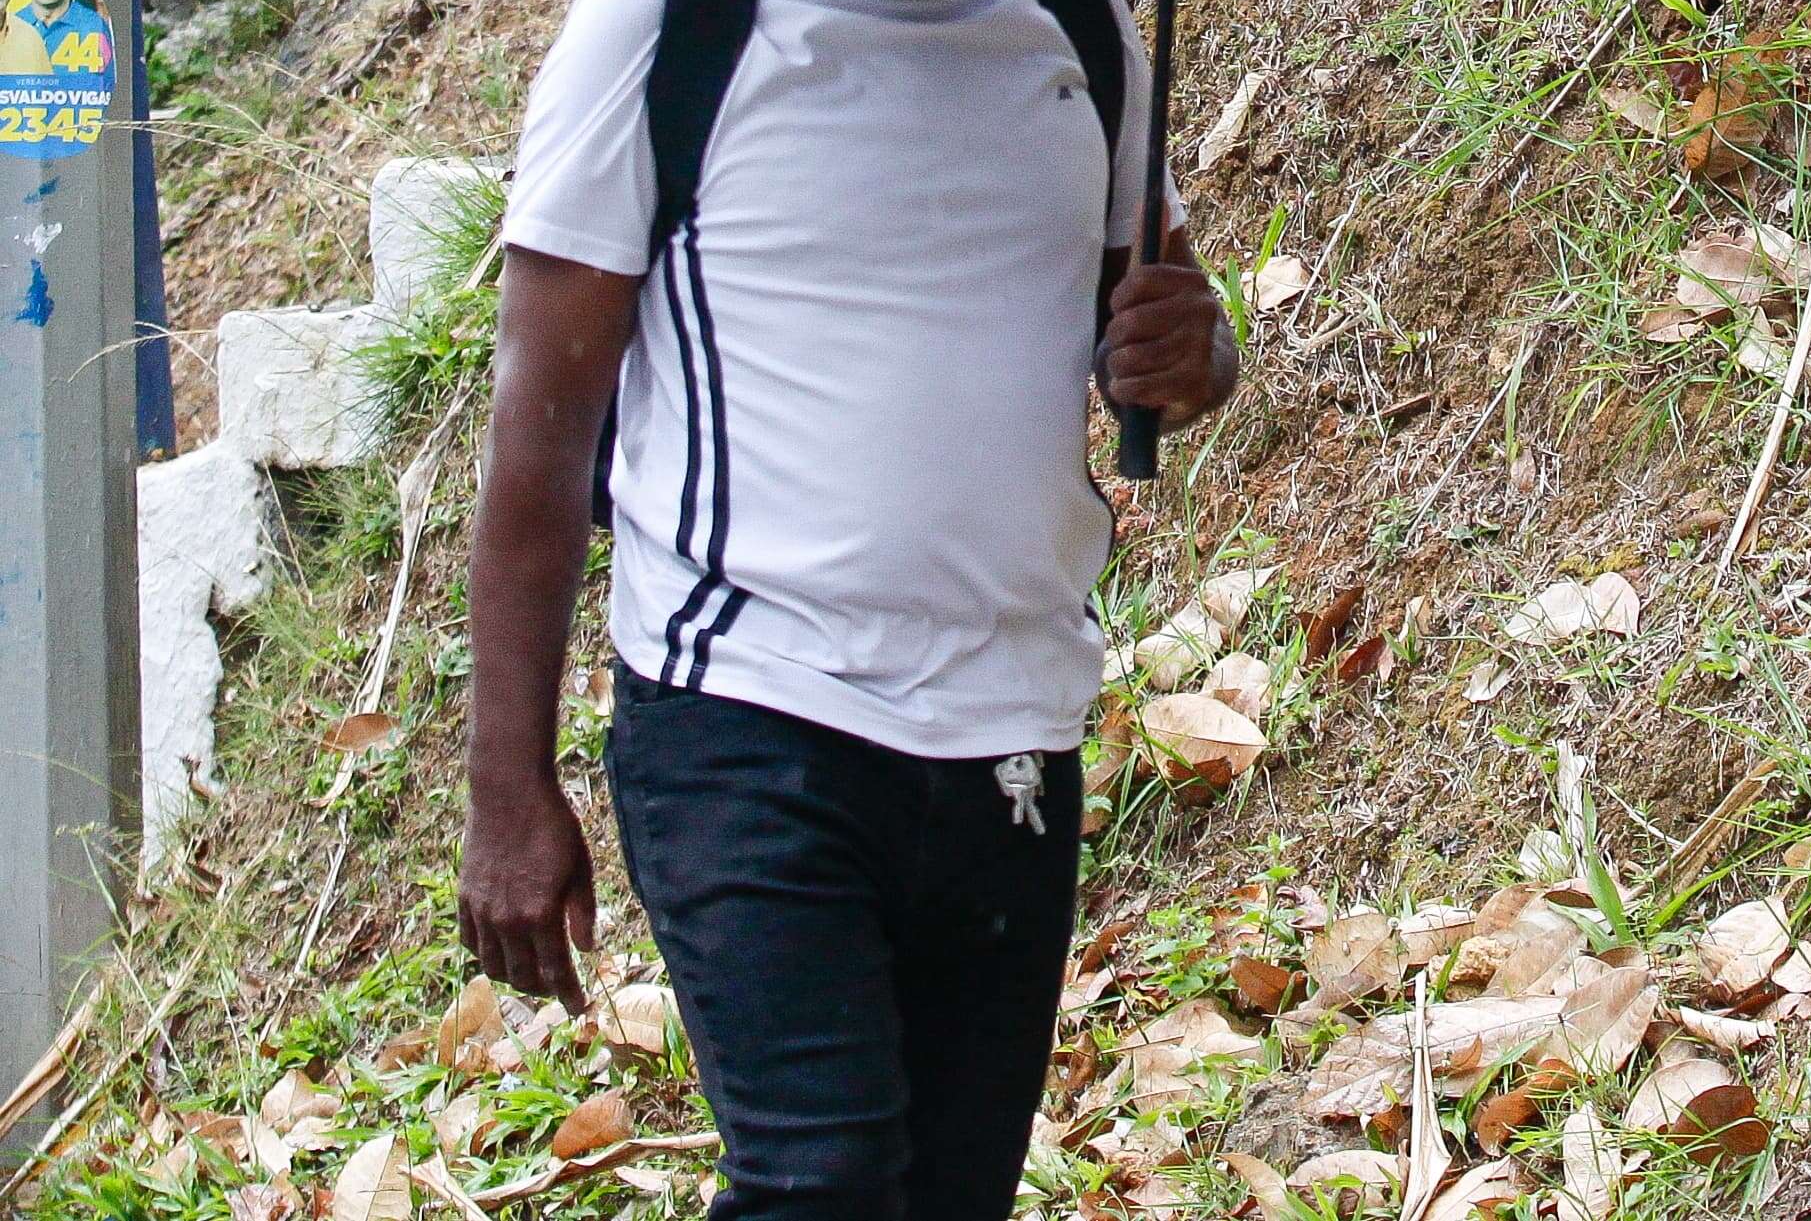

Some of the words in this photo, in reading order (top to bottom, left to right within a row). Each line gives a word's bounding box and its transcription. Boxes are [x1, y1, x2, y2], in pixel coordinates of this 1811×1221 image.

[52, 32, 104, 74] 44
[15, 78, 60, 86] VEREADOR
[0, 107, 103, 144] 2345
